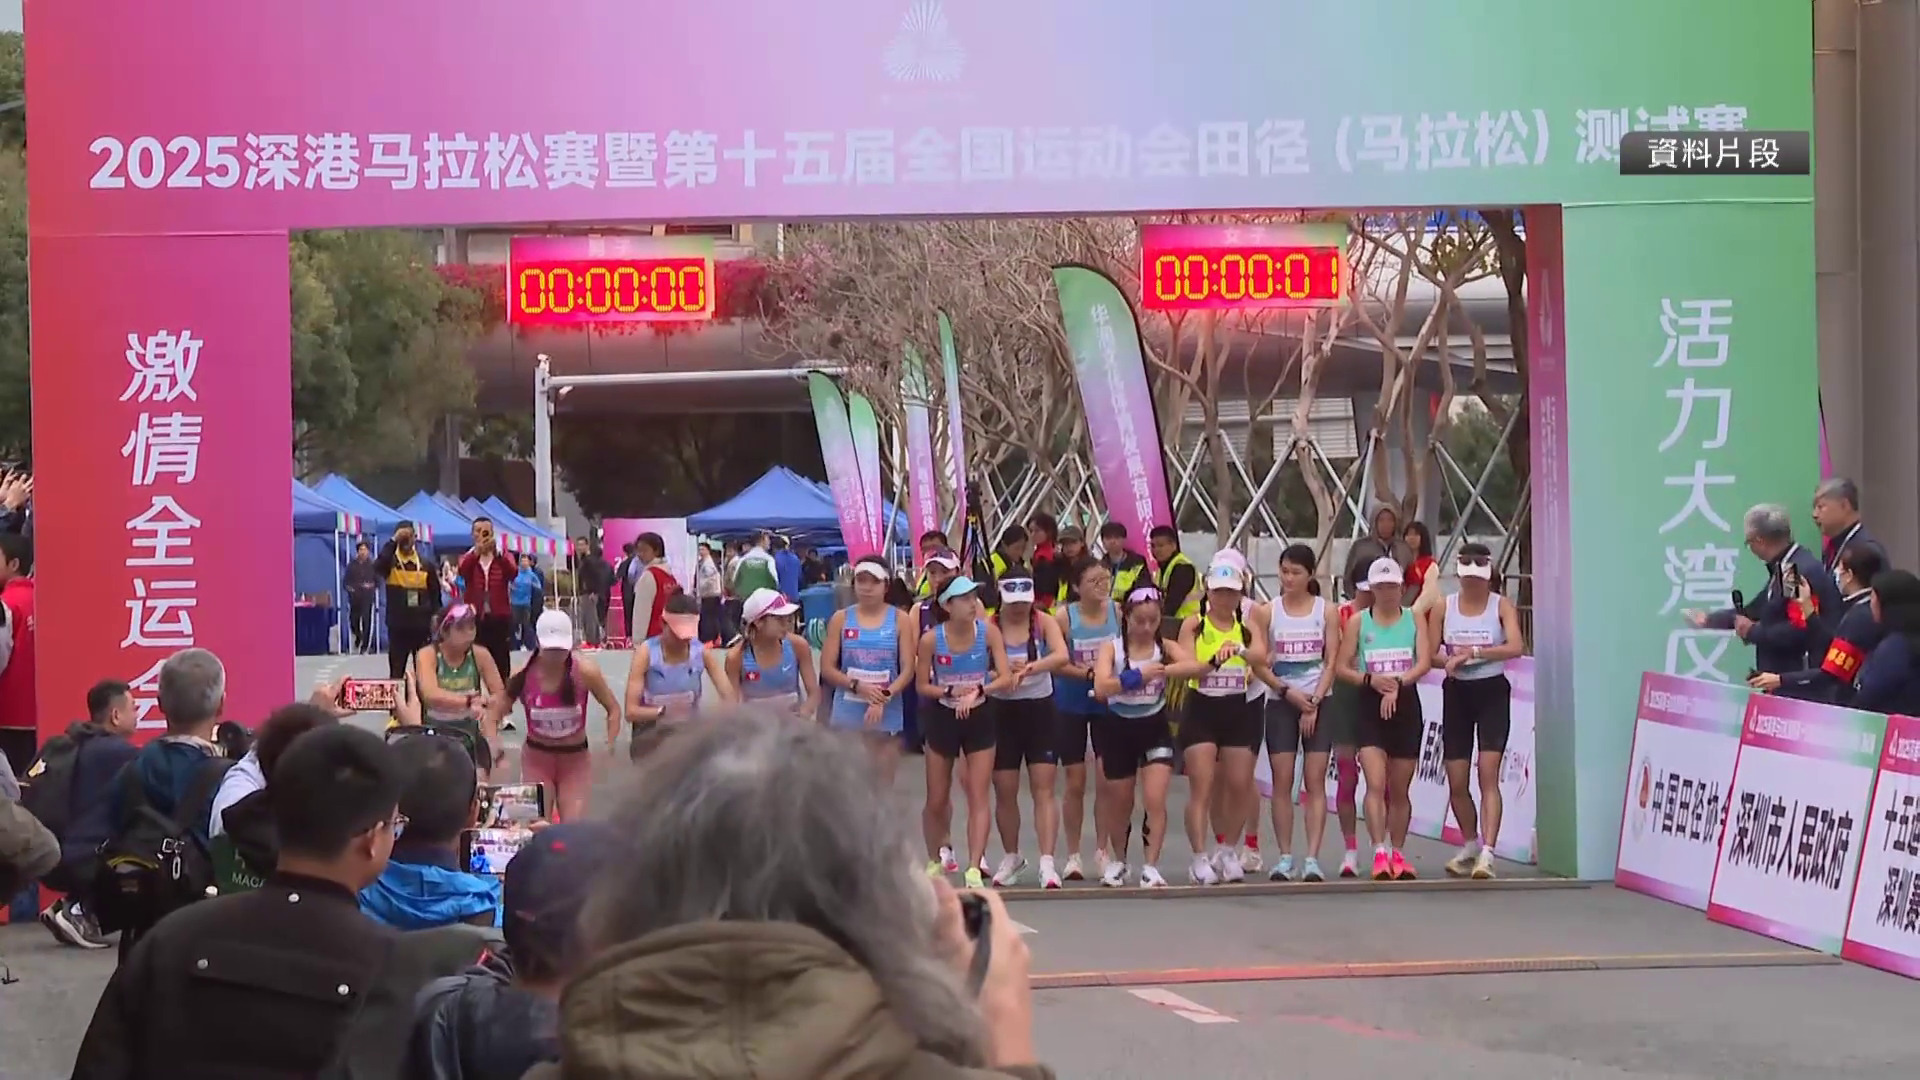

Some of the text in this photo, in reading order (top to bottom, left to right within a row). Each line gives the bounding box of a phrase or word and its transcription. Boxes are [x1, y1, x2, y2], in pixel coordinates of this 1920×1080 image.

[520, 266, 705, 314] 00:00:00
[1155, 253, 1338, 300] 00:00:01
[1653, 298, 1740, 682] 活力大湾区
[1728, 791, 1854, 890] 深圳市人民政府
